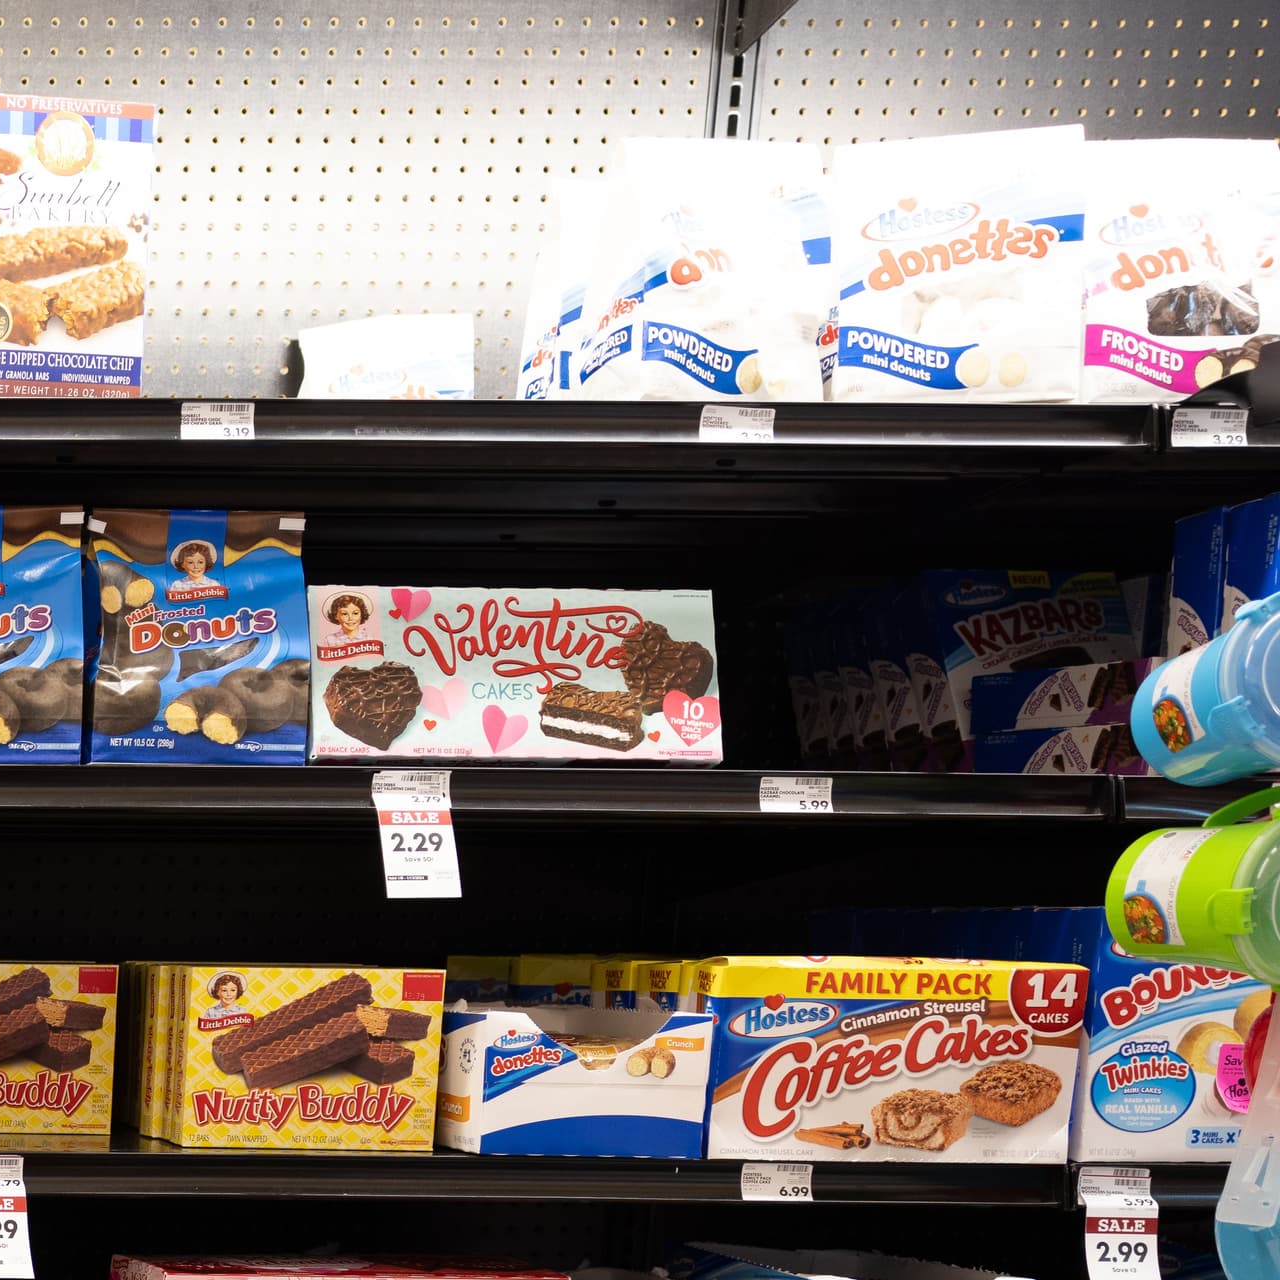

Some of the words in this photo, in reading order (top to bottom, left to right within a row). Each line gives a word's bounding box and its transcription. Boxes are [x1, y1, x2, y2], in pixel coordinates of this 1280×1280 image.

[868, 218, 1055, 291] donettes
[846, 329, 950, 370] POWDERED
[1101, 328, 1184, 373] FROSTED
[8, 352, 44, 367] DIPPED
[47, 353, 103, 369] CHOCOLATE
[106, 355, 135, 371] CHIP
[862, 350, 889, 370] mini
[890, 356, 932, 382] donuts
[953, 599, 1104, 656] KAZBARS
[320, 645, 346, 659] Little
[350, 642, 380, 655] Debbie
[403, 596, 644, 694] Valentine
[472, 681, 533, 701] CAKES
[682, 701, 705, 719] 10
[799, 800, 829, 811] 5.99
[391, 811, 440, 824] SALE
[391, 833, 444, 853] 2.29
[805, 972, 908, 995] FAMILY
[916, 973, 992, 994] PACK
[1026, 973, 1078, 1008] 14
[743, 1001, 830, 1034] Hostess
[840, 1005, 920, 1032] Cinnamon
[922, 998, 985, 1016] Streusel
[1028, 1012, 1069, 1024] CAKES
[667, 1039, 694, 1050] Crunch
[1121, 1041, 1168, 1056] Glazed
[491, 1047, 562, 1077] donettes
[742, 1033, 900, 1138] Coffee
[904, 1020, 1030, 1073] Cakes
[1102, 1058, 1188, 1091] Twinkies
[194, 1089, 296, 1130] Nutty
[298, 1083, 415, 1130] Buddy
[779, 1186, 808, 1196] 6.99
[1097, 1218, 1146, 1232] SALE
[1096, 1242, 1148, 1262] 2.99
